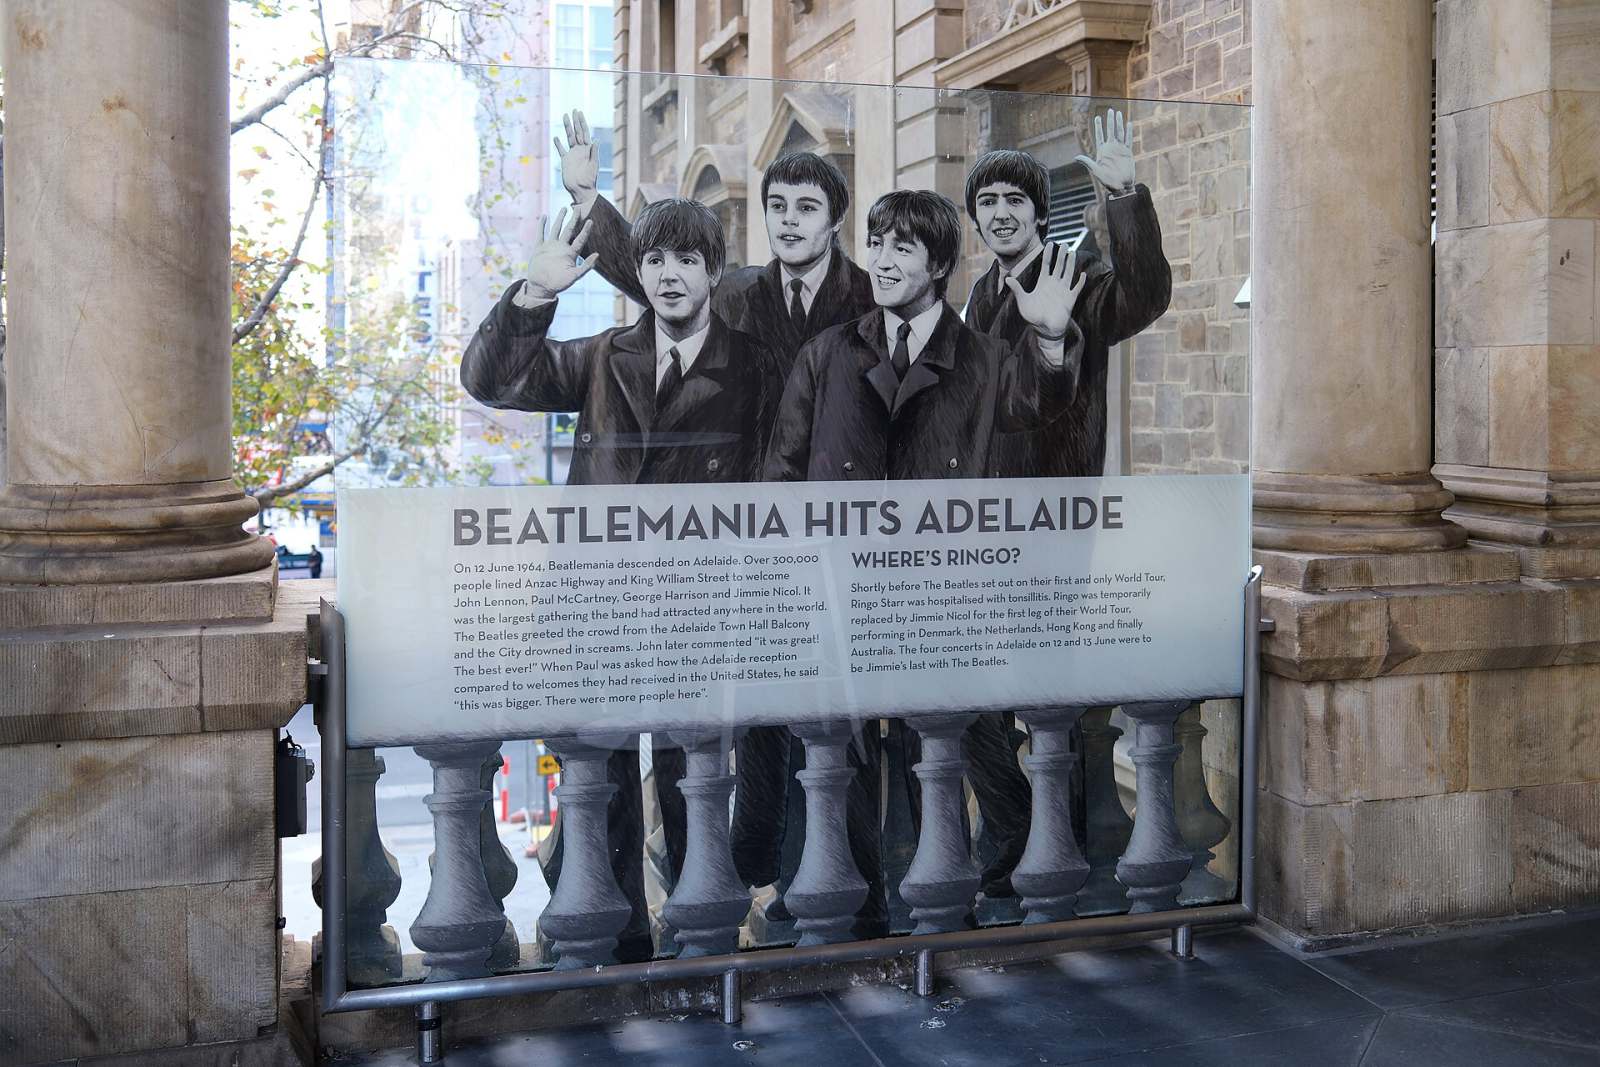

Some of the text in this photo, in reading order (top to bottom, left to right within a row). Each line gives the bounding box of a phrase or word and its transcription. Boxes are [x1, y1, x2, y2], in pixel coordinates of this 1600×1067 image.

[453, 496, 1123, 546] BEATLEMANIA HITS ADELAIDE
[454, 562, 471, 574] On
[475, 564, 485, 573] 12
[488, 562, 515, 573] June
[518, 562, 546, 573] 1964,
[548, 559, 614, 571] Beatlemania
[617, 557, 675, 569] descended
[693, 555, 741, 567] Adelaide.
[744, 554, 770, 565] Over
[772, 555, 819, 566] 300,000
[851, 547, 1021, 568] WHERE’S RINGO?
[454, 569, 790, 594] people lined Anzac Highway and King William Street welcome
[851, 581, 886, 595] Shortly
[888, 580, 921, 592] before
[922, 579, 942, 591] The
[944, 578, 979, 590] Beatles
[981, 578, 996, 588] set
[998, 578, 1014, 588] out
[1030, 576, 1051, 587] their
[1054, 575, 1072, 586] first
[1074, 574, 1092, 585] and
[1093, 574, 1113, 586] only
[1114, 572, 1142, 583] World
[1144, 572, 1166, 582] Tour,
[454, 586, 801, 608] John Lennon, Paul McCartney, George Harrison and Jimmie Nicol.
[851, 588, 1151, 612] Ringo Starr was hospitalised with tonsillitis. Ringo was temporarily
[454, 601, 827, 626] was the largest gathering the band had attracted anywhere the world.
[850, 603, 1132, 627] replaced by Jimmie Nicol for the first leg their World Tour,
[454, 618, 810, 643] The Beatles greeted the crowd from the Adelaide Town Hall Balcony
[850, 618, 1143, 643] performing Denmark, the Netherlands, Hong Kong and finally
[454, 634, 819, 660] and the City drowned screams. John later commented was great!
[850, 645, 896, 657] Australia.
[898, 644, 917, 655] The
[919, 642, 939, 654] four
[942, 642, 983, 653] concerts
[996, 638, 1037, 650] Adelaide
[1053, 639, 1062, 647] 12
[1064, 636, 1081, 647] and
[1083, 637, 1092, 647] 13
[1094, 635, 1116, 645] June
[1118, 636, 1140, 644] were
[454, 651, 798, 677] The best When Paul was asked how the Adelaide reception
[850, 662, 864, 673] be
[909, 659, 926, 670] last
[928, 658, 949, 669] with
[949, 657, 970, 668] The
[972, 655, 1010, 667] Beatles.
[454, 666, 819, 696] compared welcomes they had received the United States, he said
[482, 689, 675, 711] was bigger. There were more people
